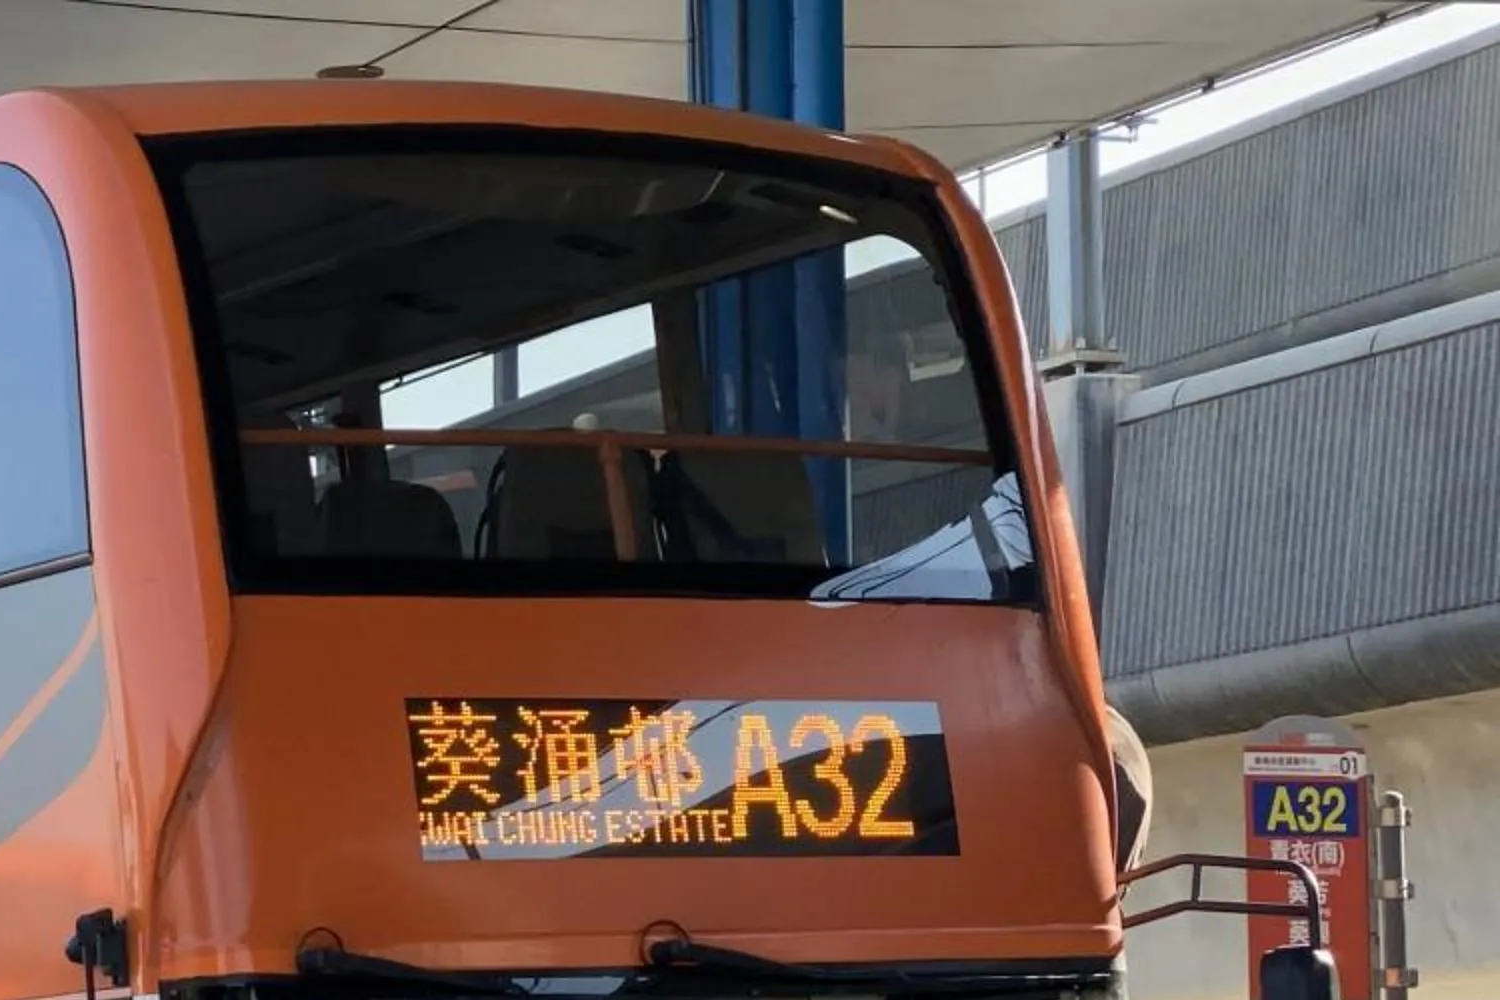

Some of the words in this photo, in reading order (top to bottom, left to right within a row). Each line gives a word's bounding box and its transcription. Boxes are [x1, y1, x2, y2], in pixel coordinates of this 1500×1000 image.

[409, 701, 703, 807] 葵涌邨
[732, 714, 915, 838] A32
[1339, 756, 1358, 775] 01
[501, 810, 597, 845] CHUNG
[605, 809, 732, 844] ESTATE
[1267, 786, 1347, 833] A32
